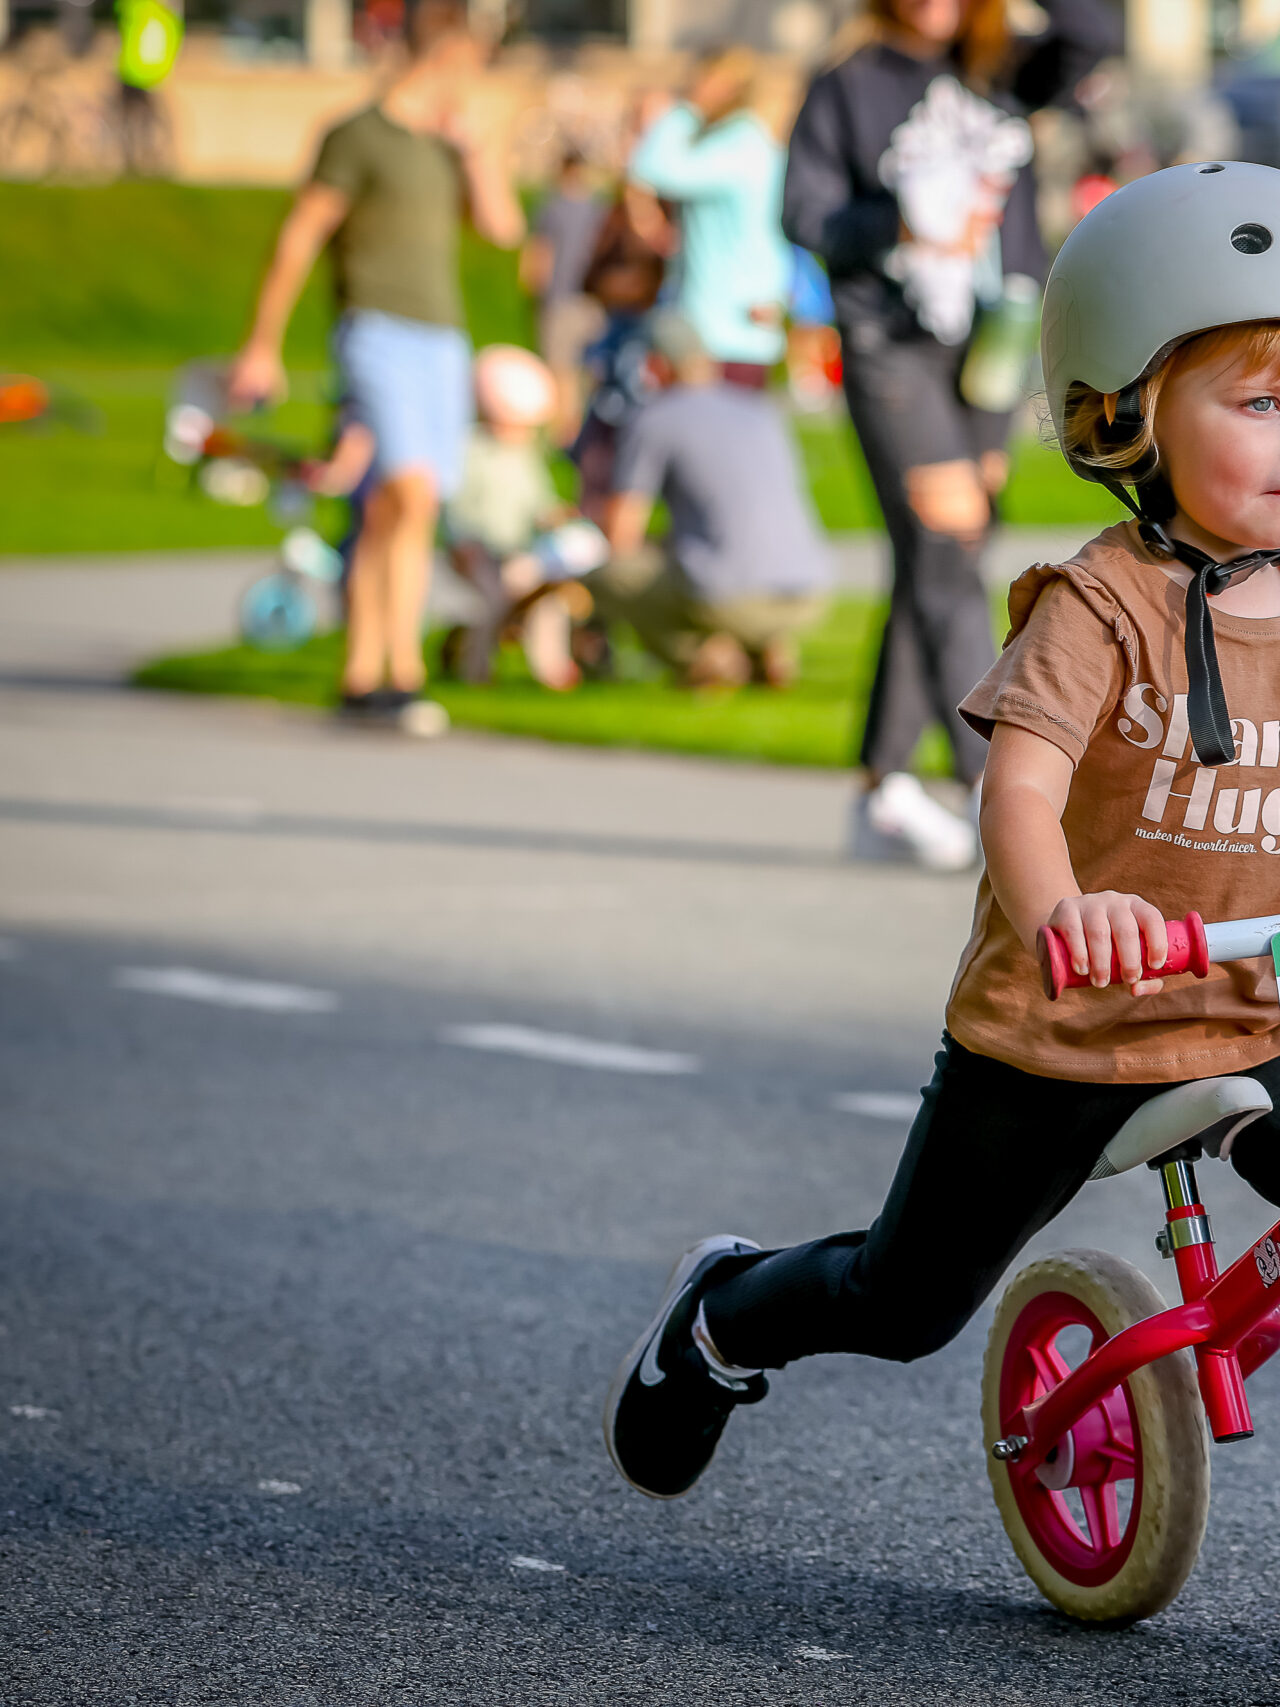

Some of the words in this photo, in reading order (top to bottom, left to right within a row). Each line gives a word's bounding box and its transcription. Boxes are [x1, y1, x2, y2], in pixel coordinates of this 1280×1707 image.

[1135, 827, 1172, 842] makes
[1173, 834, 1192, 848] the
[1193, 839, 1228, 852] world
[1228, 842, 1257, 853] nicer.
